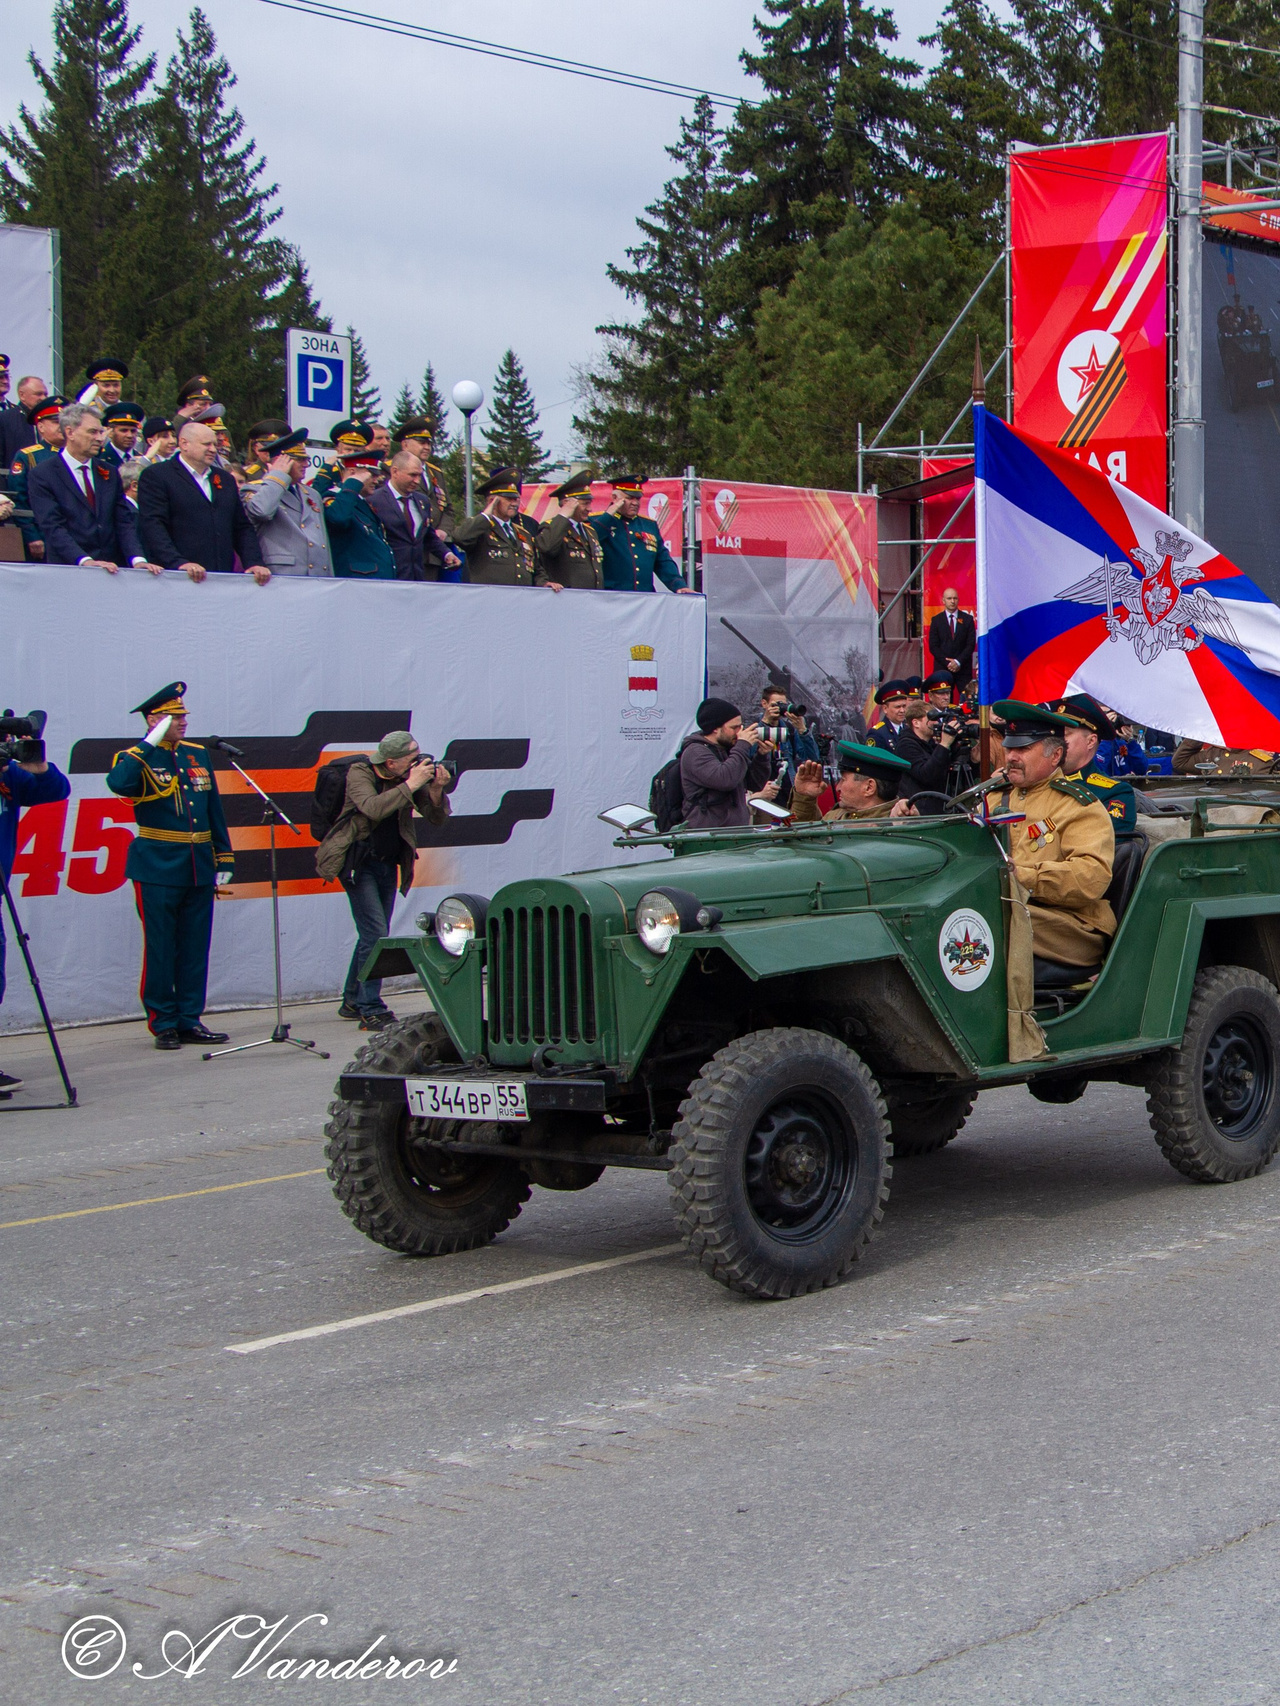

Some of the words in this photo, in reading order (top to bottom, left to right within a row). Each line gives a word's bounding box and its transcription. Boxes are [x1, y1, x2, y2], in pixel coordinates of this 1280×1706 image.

[1259, 212, 1268, 227] С
[301, 336, 340, 354] ЗОНА
[307, 360, 333, 402] P
[1074, 450, 1127, 482] АЯ
[715, 535, 742, 549] МАЯ
[497, 1085, 520, 1107] 55
[499, 1108, 515, 1116] RUS
